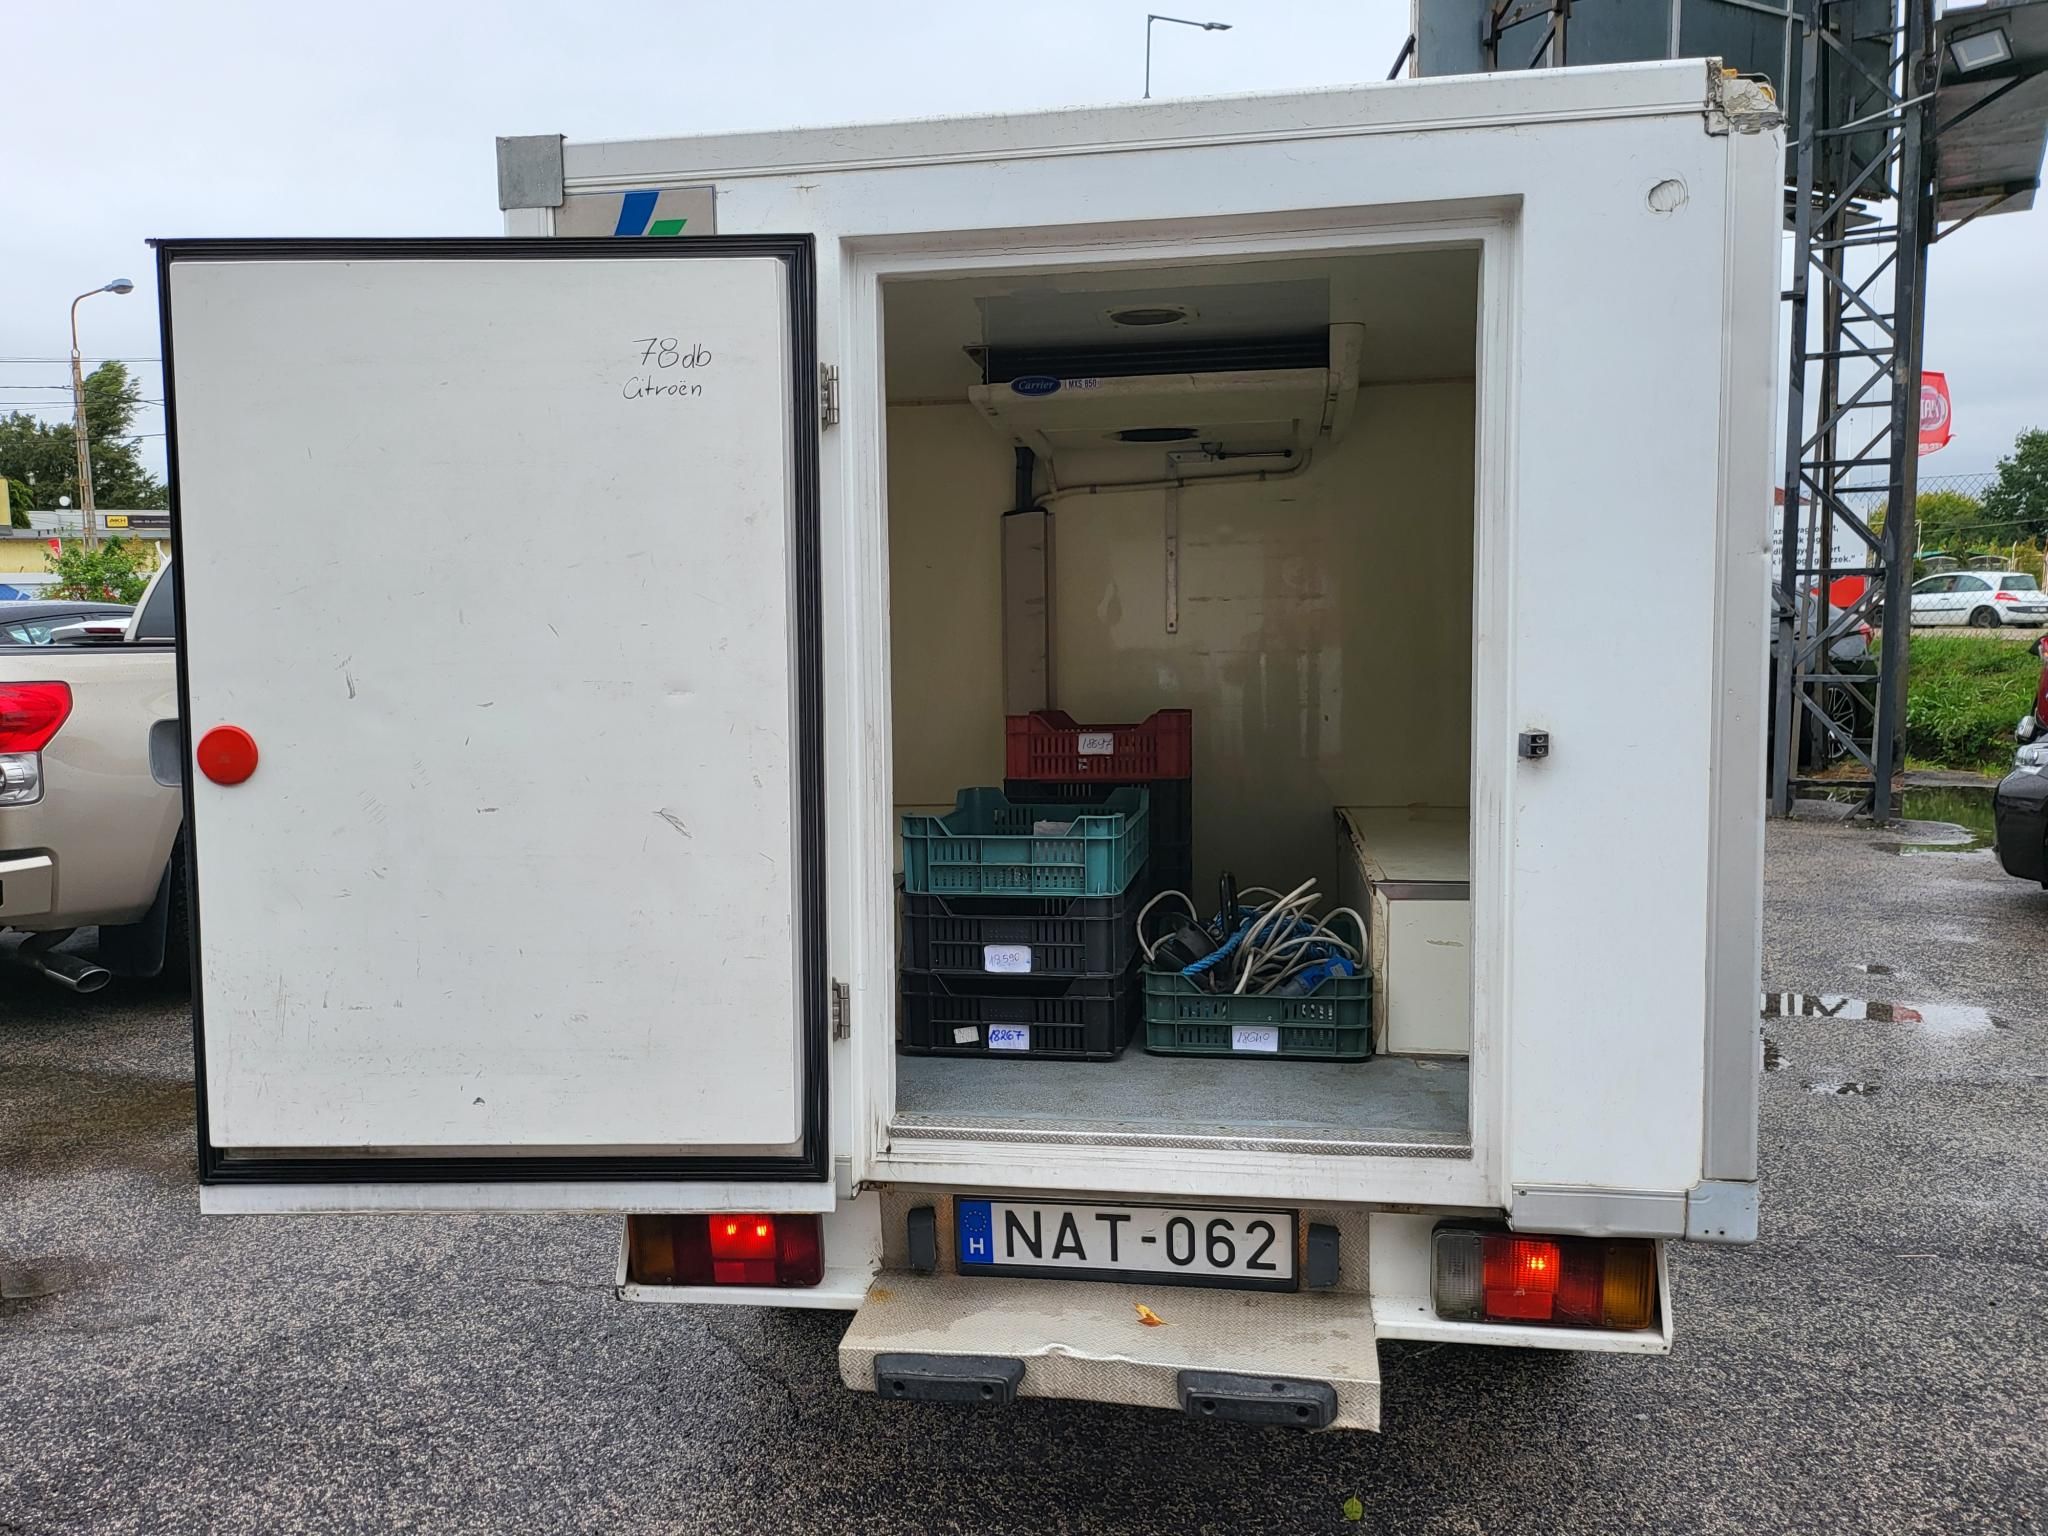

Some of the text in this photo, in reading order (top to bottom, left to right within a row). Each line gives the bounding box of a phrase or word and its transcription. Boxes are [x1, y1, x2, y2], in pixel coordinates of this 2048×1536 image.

[1018, 380, 1055, 391] Carrier
[989, 1029, 1025, 1043] 18267
[969, 1237, 985, 1255] H
[1005, 1209, 1278, 1271] NAT-062
